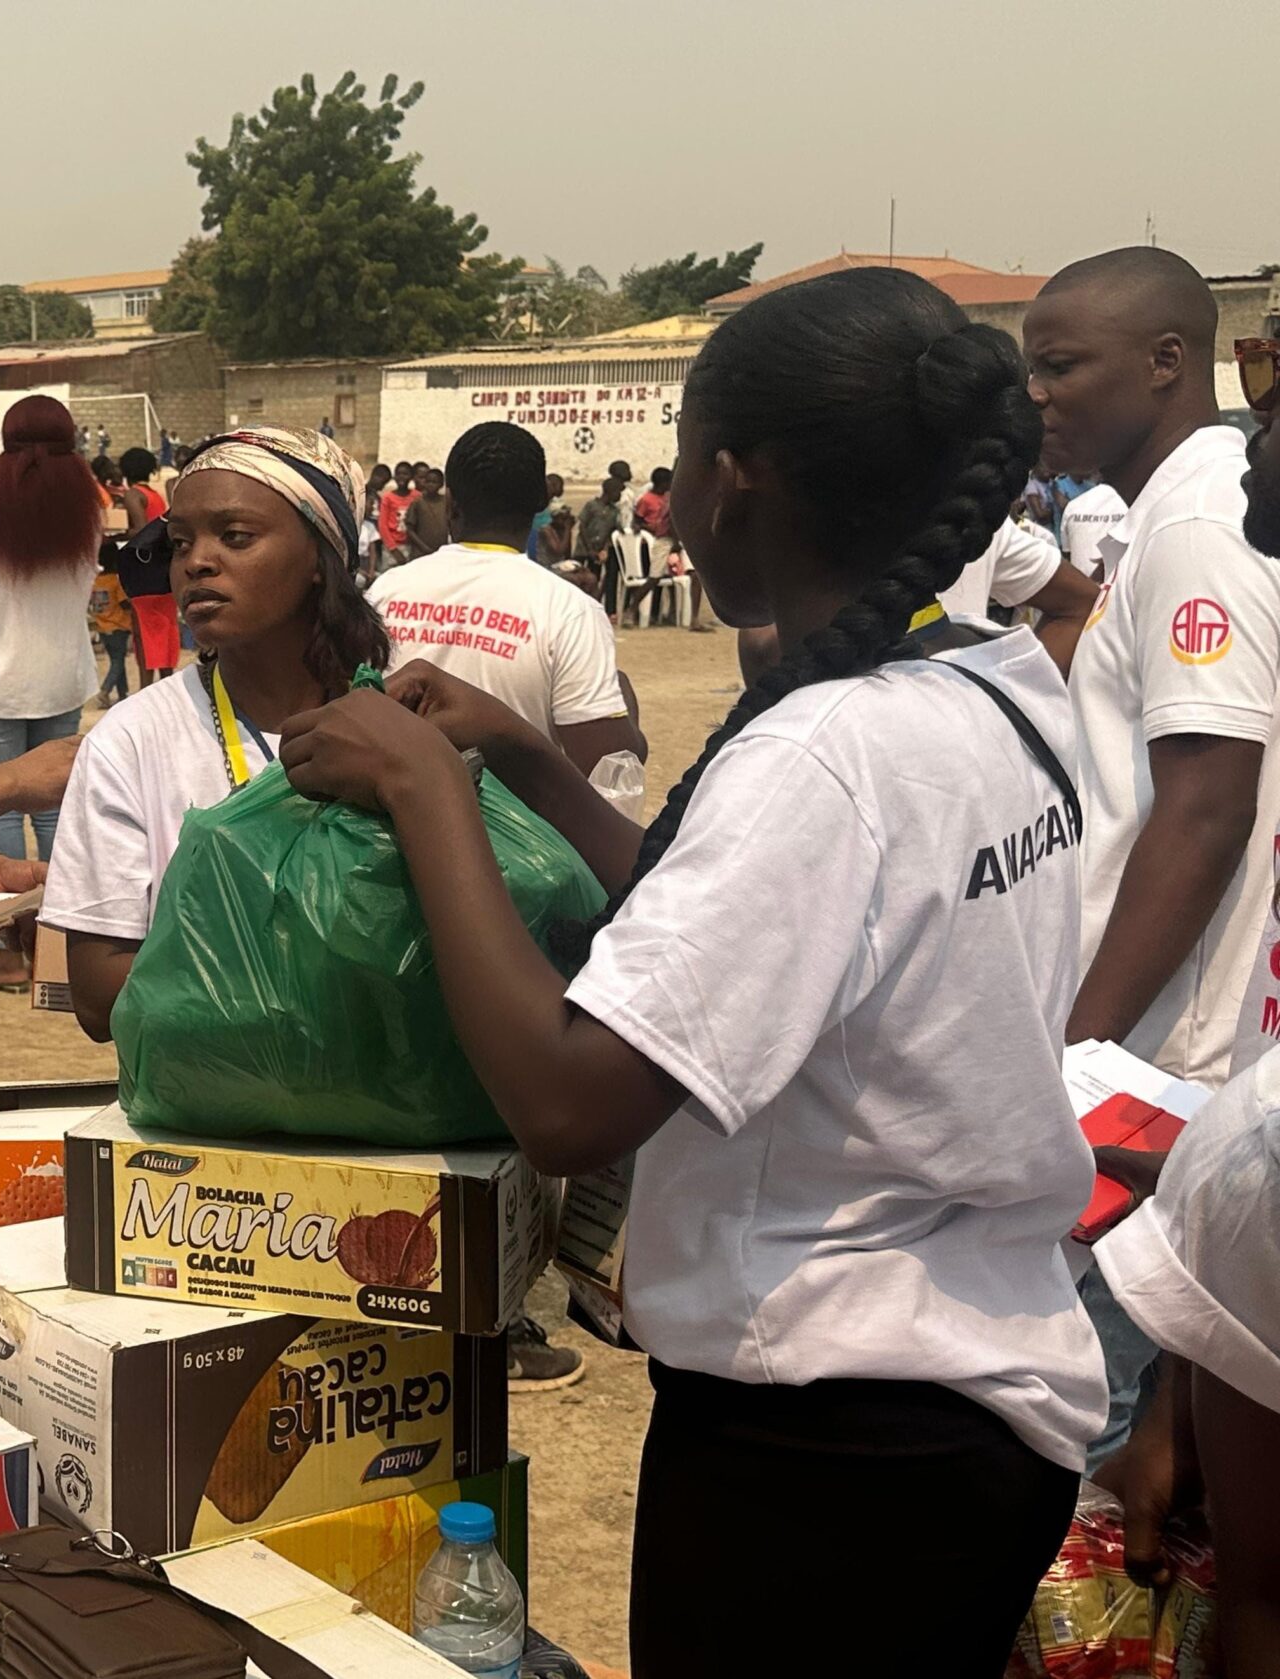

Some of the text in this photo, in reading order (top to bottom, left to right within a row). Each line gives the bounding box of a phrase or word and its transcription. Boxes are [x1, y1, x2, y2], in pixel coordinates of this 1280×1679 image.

[472, 391, 508, 407] CAMPO
[515, 390, 531, 406] DO
[597, 390, 611, 401] DO
[385, 601, 532, 644] PRATIQUE O BEM,
[473, 635, 518, 660] FELIZ!
[141, 1153, 183, 1171] Natal
[195, 1186, 266, 1206] BOLACHA
[121, 1178, 338, 1262] Maria
[186, 1253, 256, 1277] CACAU
[366, 1293, 432, 1314] 24X60G
[183, 1353, 192, 1369] g
[195, 1353, 213, 1369] 50
[228, 1346, 245, 1361] 48
[51, 1423, 97, 1455] SANABEL
[380, 1450, 424, 1474] Natal
